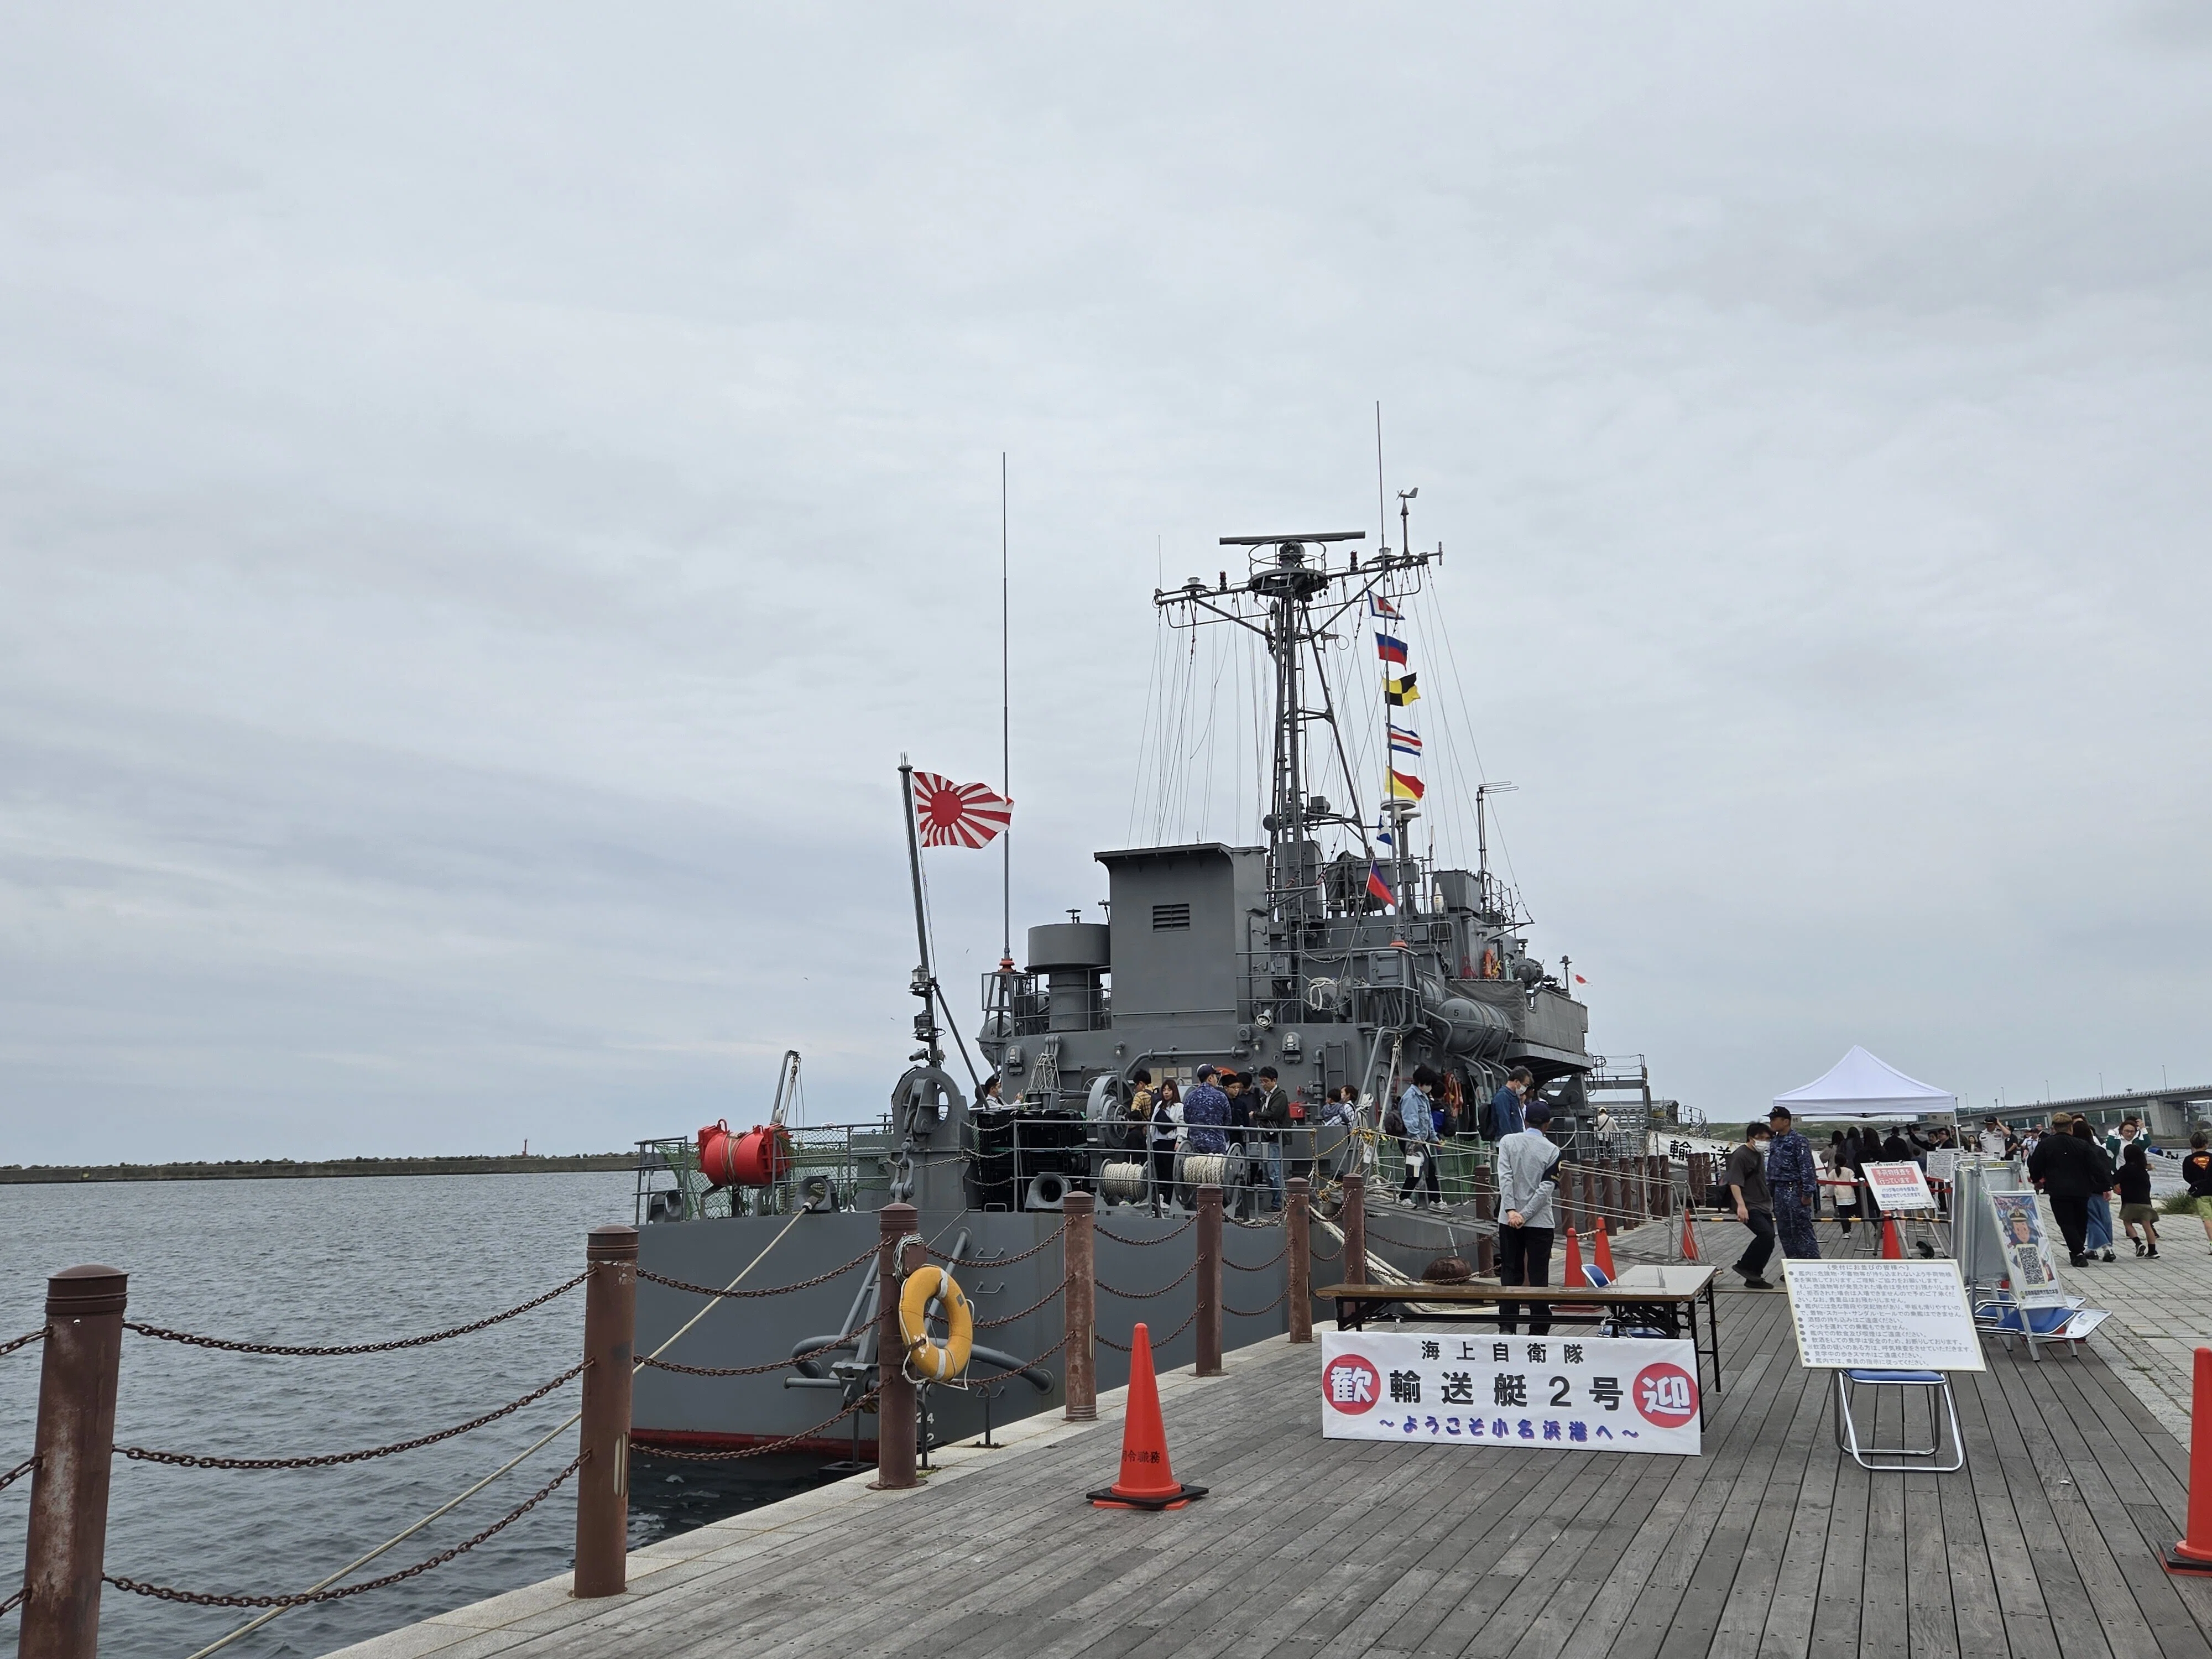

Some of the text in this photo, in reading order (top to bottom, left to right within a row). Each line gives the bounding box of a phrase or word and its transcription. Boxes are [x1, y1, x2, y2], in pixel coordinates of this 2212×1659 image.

[1422, 1340, 1584, 1364] 海上自衛隊
[1329, 1366, 1373, 1403] 歓
[1390, 1369, 1624, 1411] 輸送艇2号
[1642, 1375, 1691, 1415] 迎
